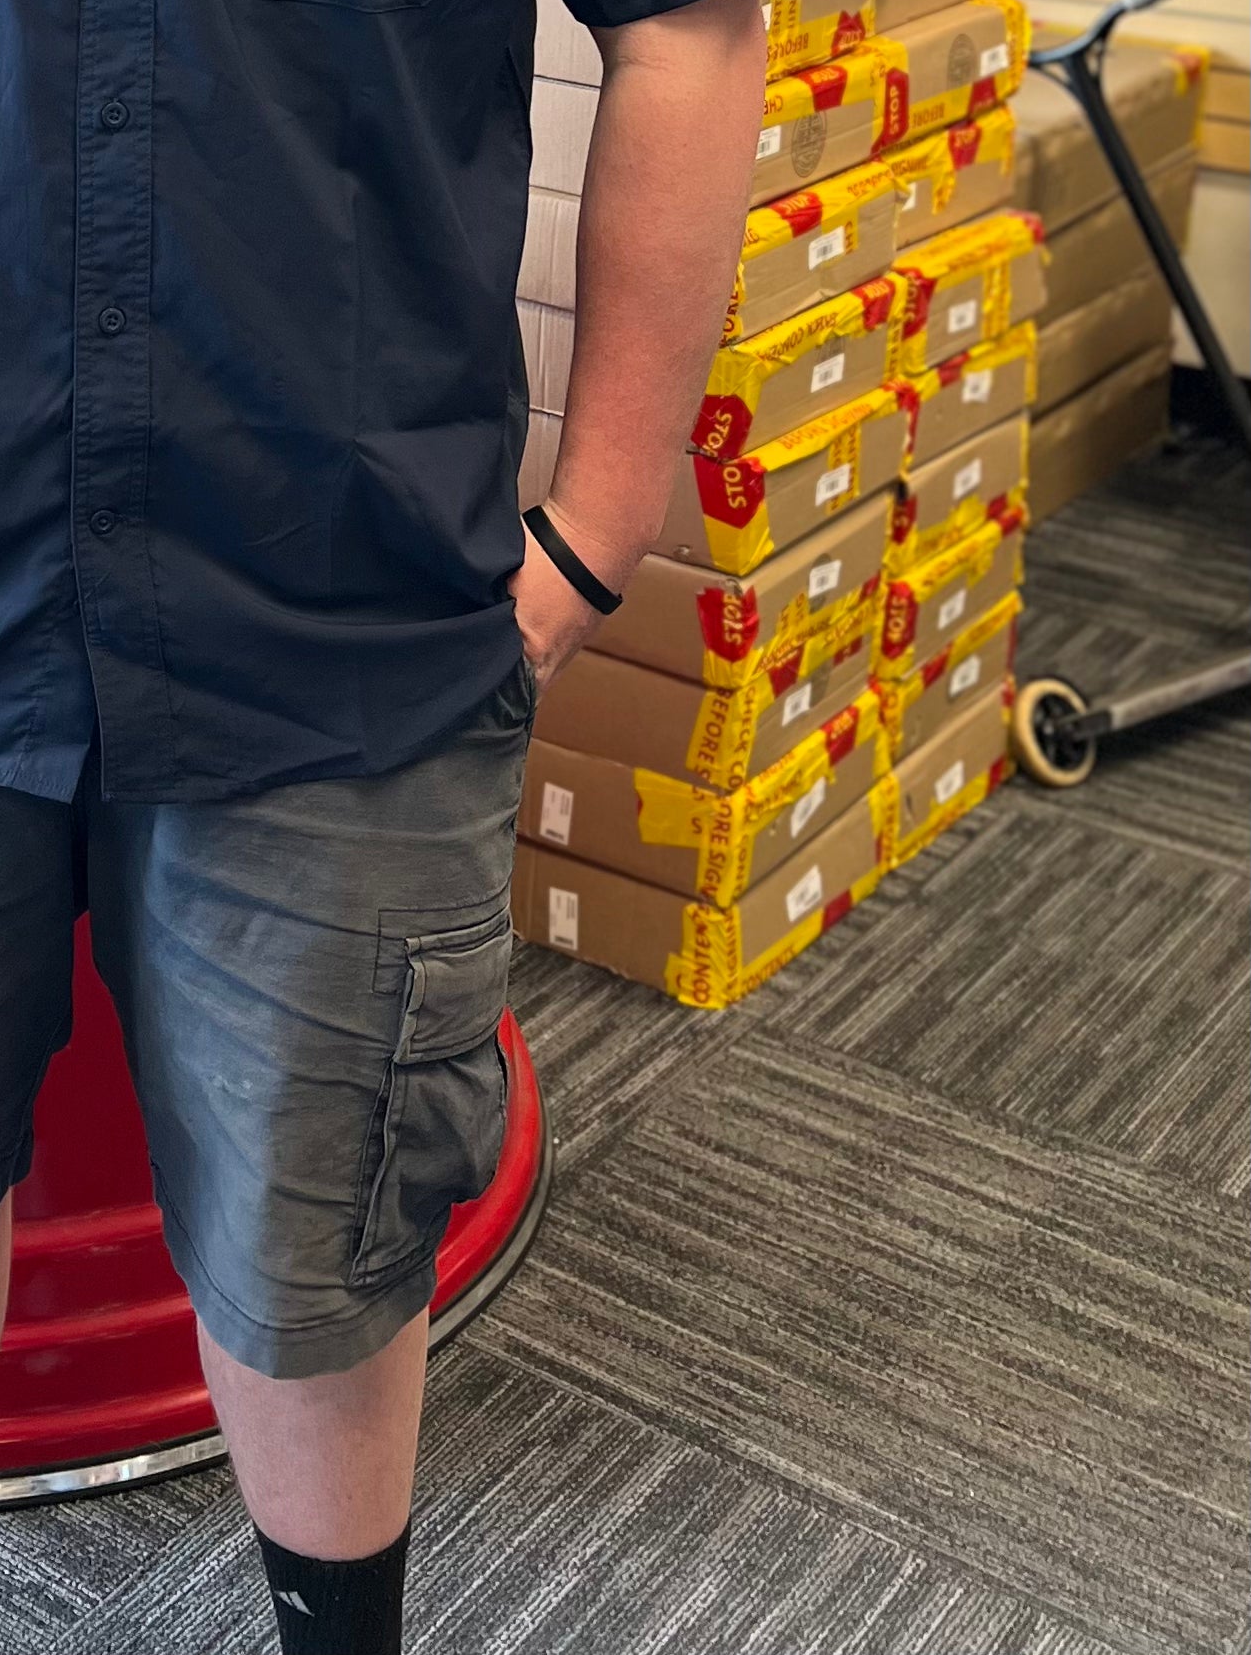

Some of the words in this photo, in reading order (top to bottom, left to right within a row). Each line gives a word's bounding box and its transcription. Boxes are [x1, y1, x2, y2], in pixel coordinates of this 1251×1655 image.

[889, 85, 900, 135] STOP
[722, 466, 747, 509] STO
[697, 687, 733, 764] BEFORE
